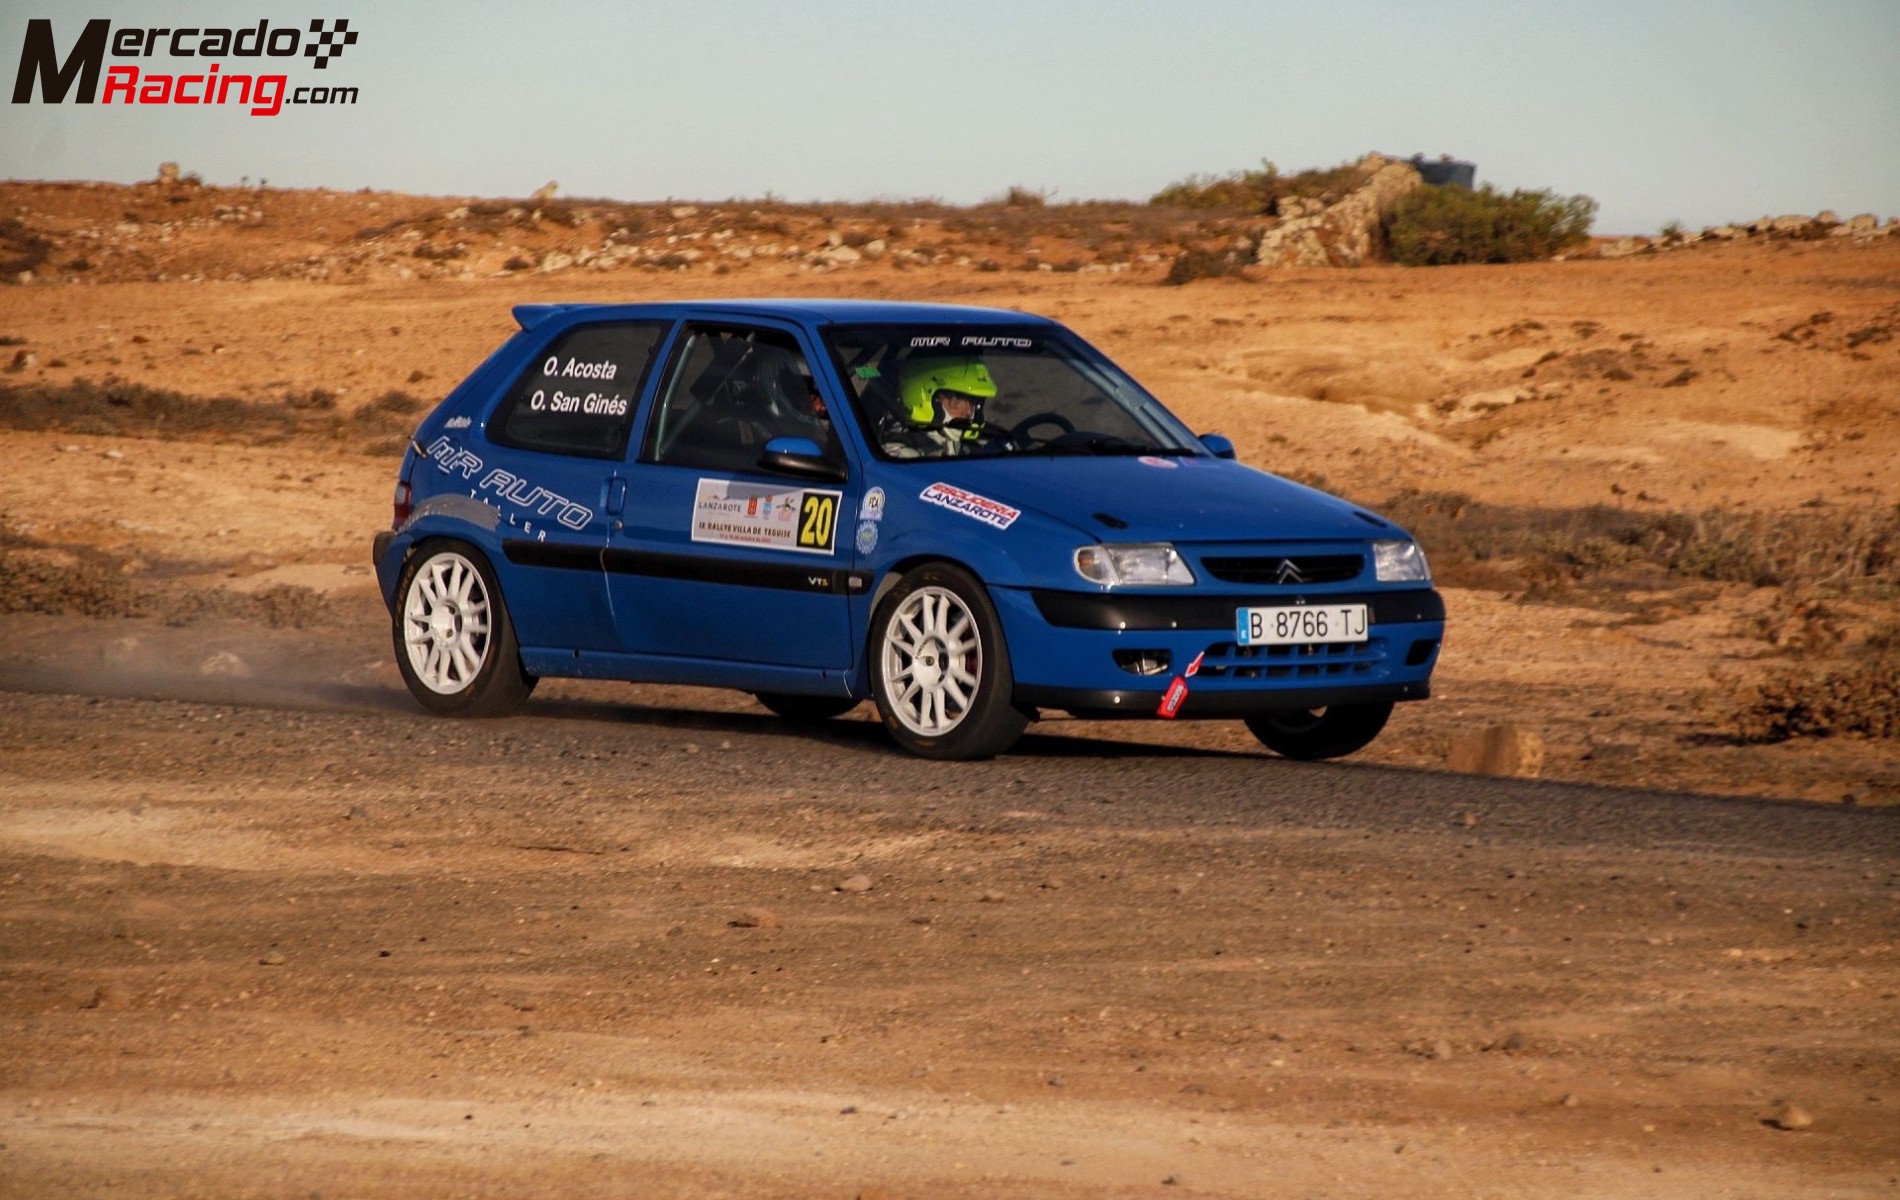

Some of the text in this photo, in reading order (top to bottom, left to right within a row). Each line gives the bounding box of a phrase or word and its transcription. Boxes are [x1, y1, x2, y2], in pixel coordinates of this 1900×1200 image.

[911, 336, 1031, 347] MR AUTO
[543, 356, 617, 379] O. Acosta
[531, 389, 627, 415] O. San Ginés
[426, 435, 593, 530] MR AUTO
[699, 502, 742, 513] LANZAROTE
[922, 489, 1012, 526] LANZAROTE
[933, 483, 1017, 518] ESCUDERIA
[707, 523, 731, 532] RALLYE
[733, 525, 752, 534] VILLA
[764, 528, 791, 538] TEGUISE
[800, 496, 833, 546] 20
[1251, 609, 1365, 639] B 8766 TJ
